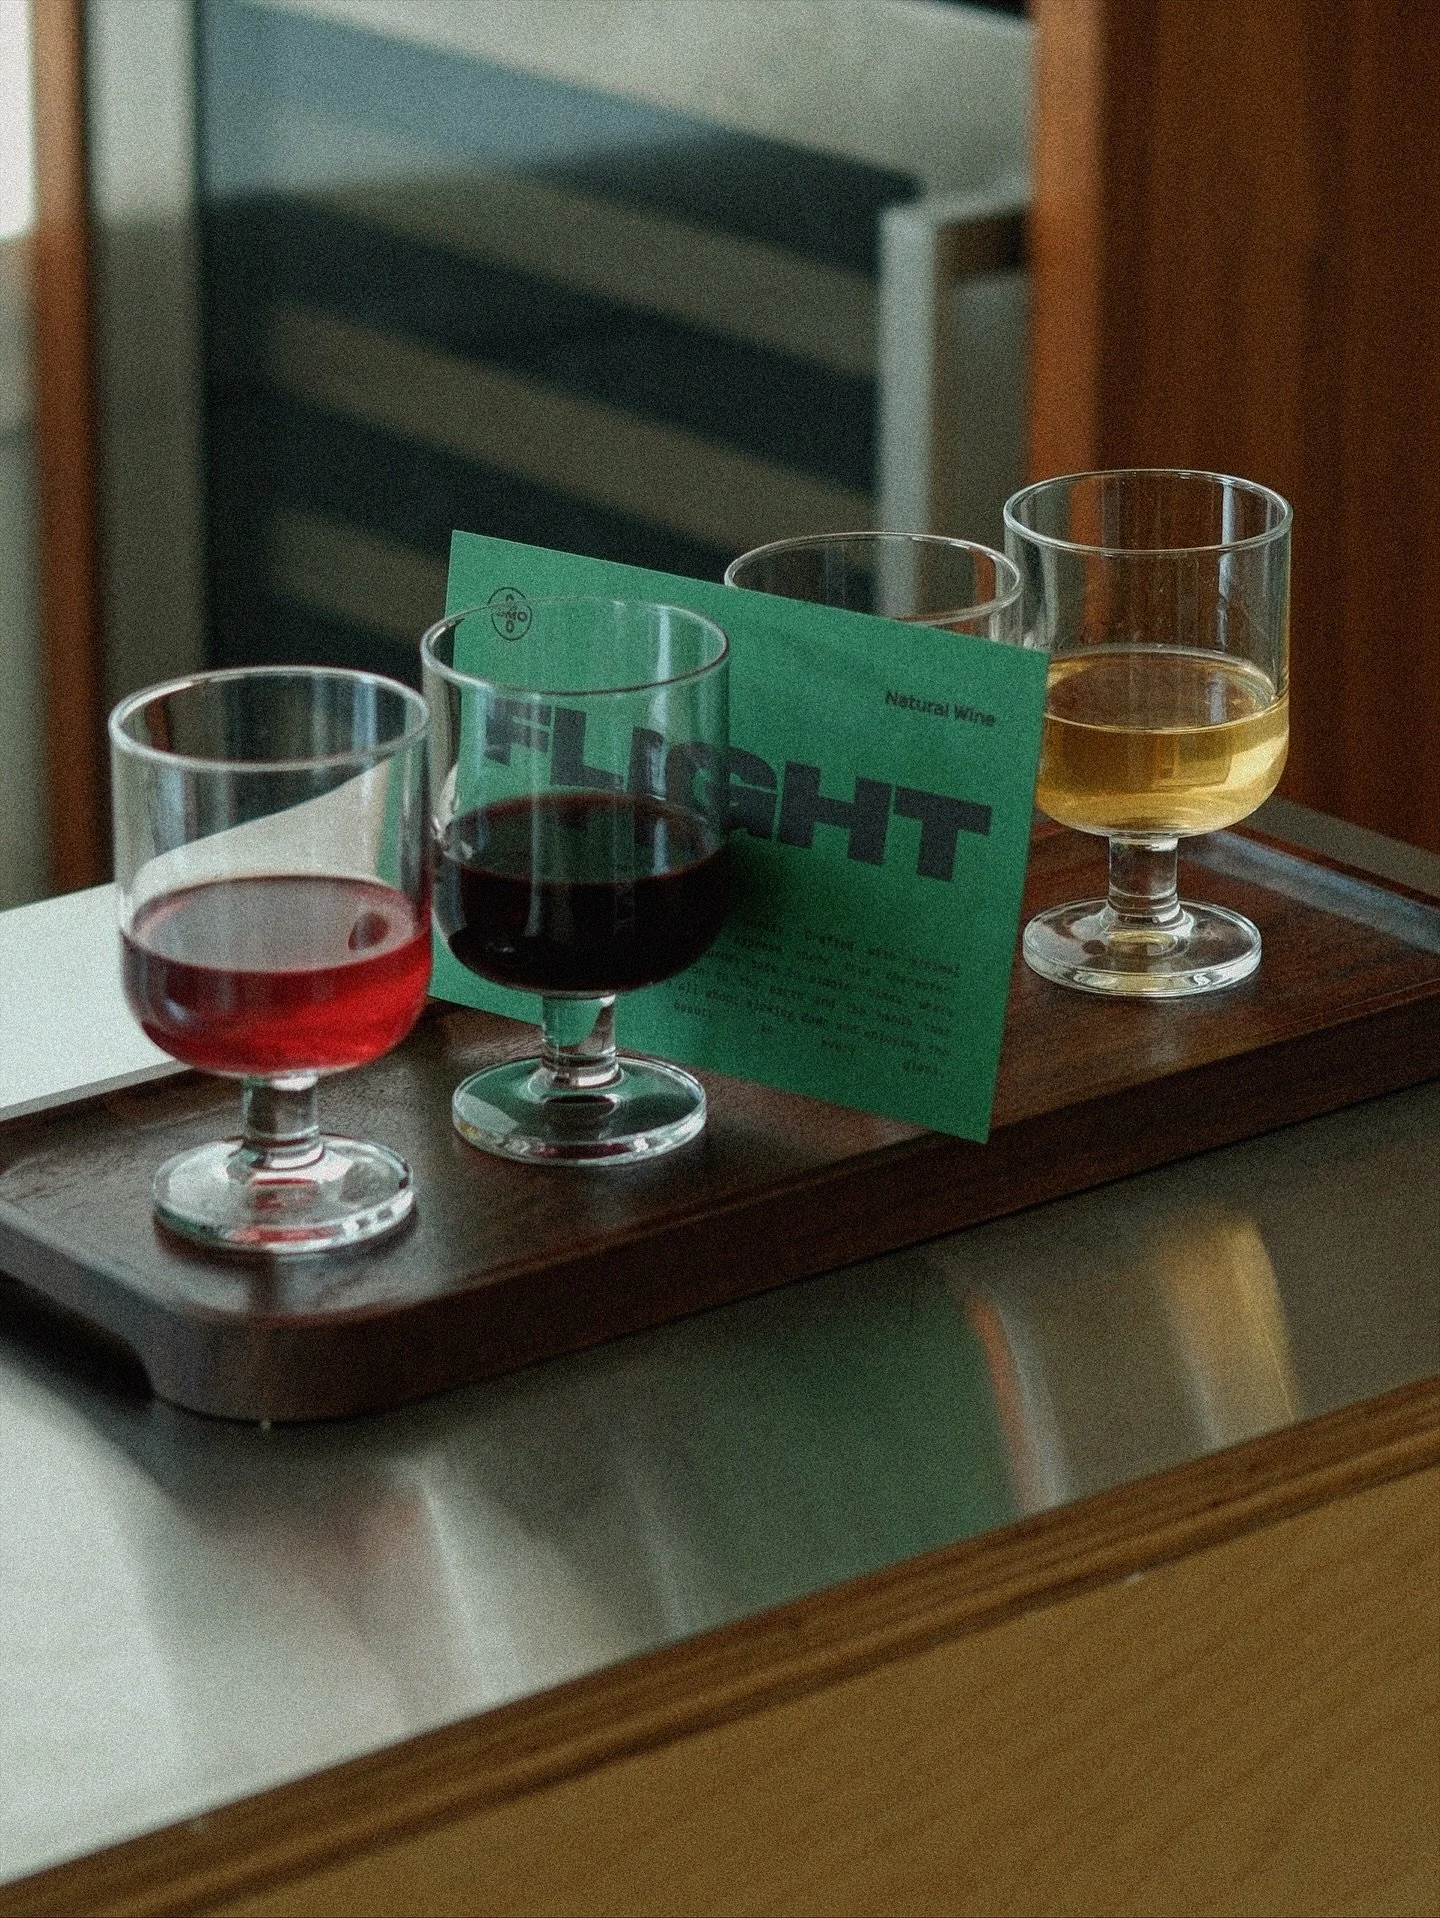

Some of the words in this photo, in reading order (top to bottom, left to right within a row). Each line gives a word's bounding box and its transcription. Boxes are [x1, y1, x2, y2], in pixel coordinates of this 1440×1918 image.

[885, 689, 950, 718] Natural
[954, 704, 998, 727] Wine
[483, 696, 994, 882] FLIGHT
